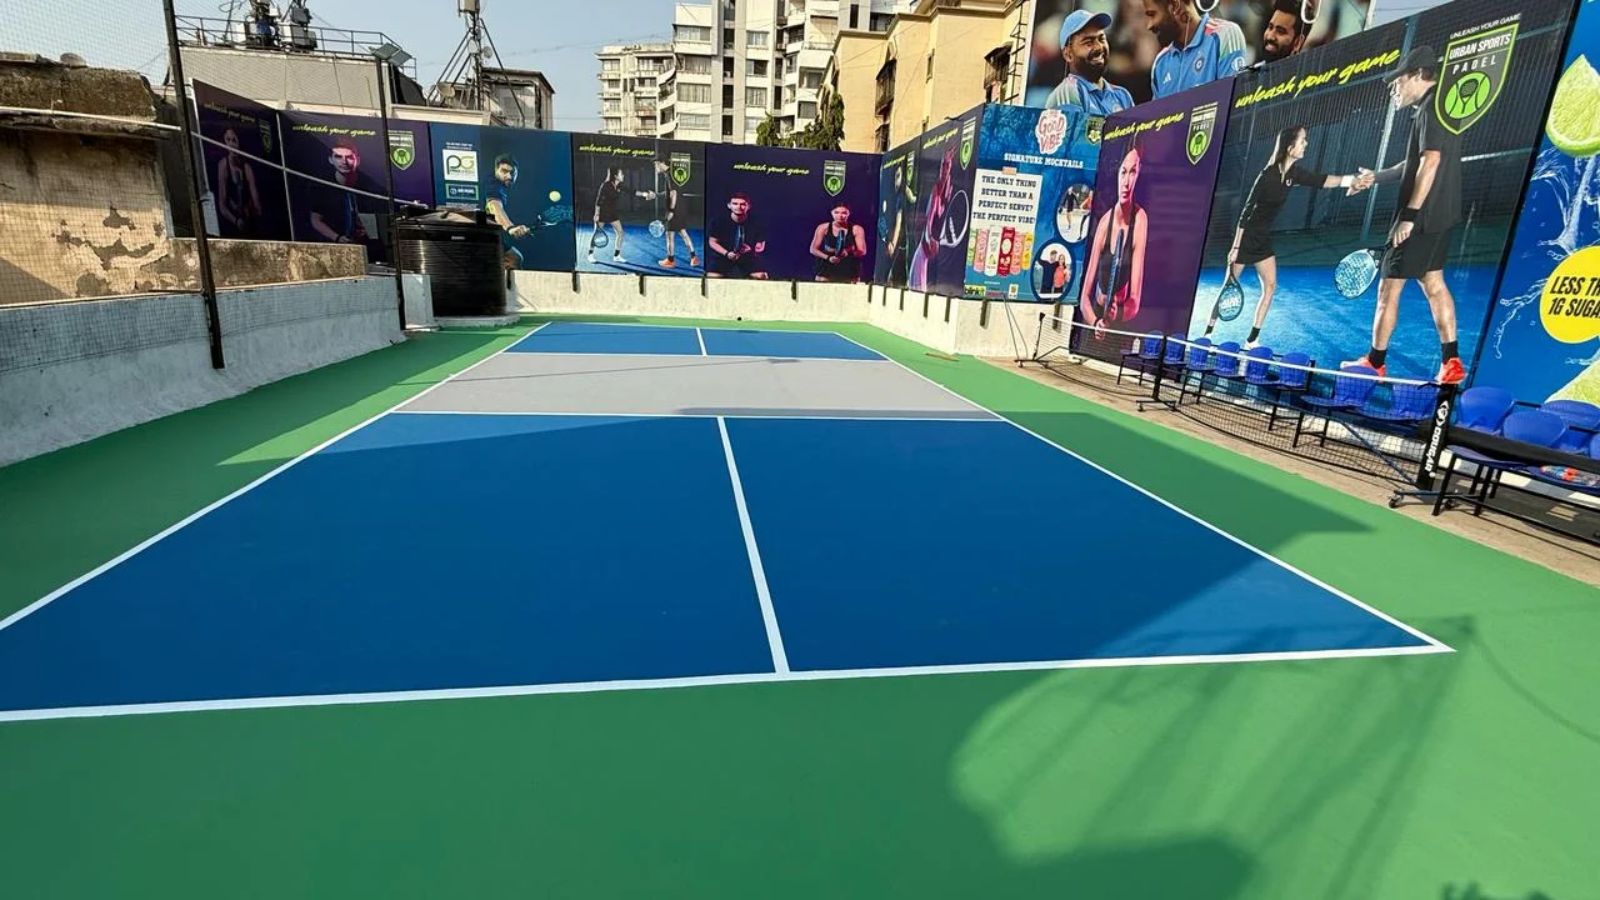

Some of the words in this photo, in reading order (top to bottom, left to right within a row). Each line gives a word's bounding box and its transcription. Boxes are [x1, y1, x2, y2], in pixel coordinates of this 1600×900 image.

[1481, 20, 1499, 30] YOUR
[1449, 42, 1477, 60] URBAN
[1477, 33, 1511, 52] SPORTS
[1452, 55, 1496, 75] PADEL
[1235, 76, 1296, 108] unleash
[1294, 68, 1338, 99] your
[1338, 49, 1400, 85] game
[329, 127, 349, 136] your
[1104, 122, 1135, 140] unleash
[1135, 120, 1156, 137] your
[1156, 112, 1184, 131] game
[580, 144, 611, 153] unleash
[612, 148, 631, 156] your
[1004, 153, 1043, 165] SIGNATURE
[1044, 157, 1084, 169] MOCKTAILS
[766, 166, 786, 174] your
[982, 175, 995, 184] THE
[997, 176, 1014, 185] ONLY
[1016, 179, 1037, 188] THING
[981, 188, 1007, 197] BETTER
[1009, 190, 1027, 199] THAN
[1028, 192, 1033, 200] A
[978, 200, 1008, 210] PERFECT
[1009, 203, 1033, 212] SERVE?
[973, 212, 985, 220] THE
[988, 212, 1016, 222] PERFECT
[1550, 276, 1585, 295] LESS
[1549, 297, 1566, 315] 1G
[1425, 426, 1442, 472] COUGAR
